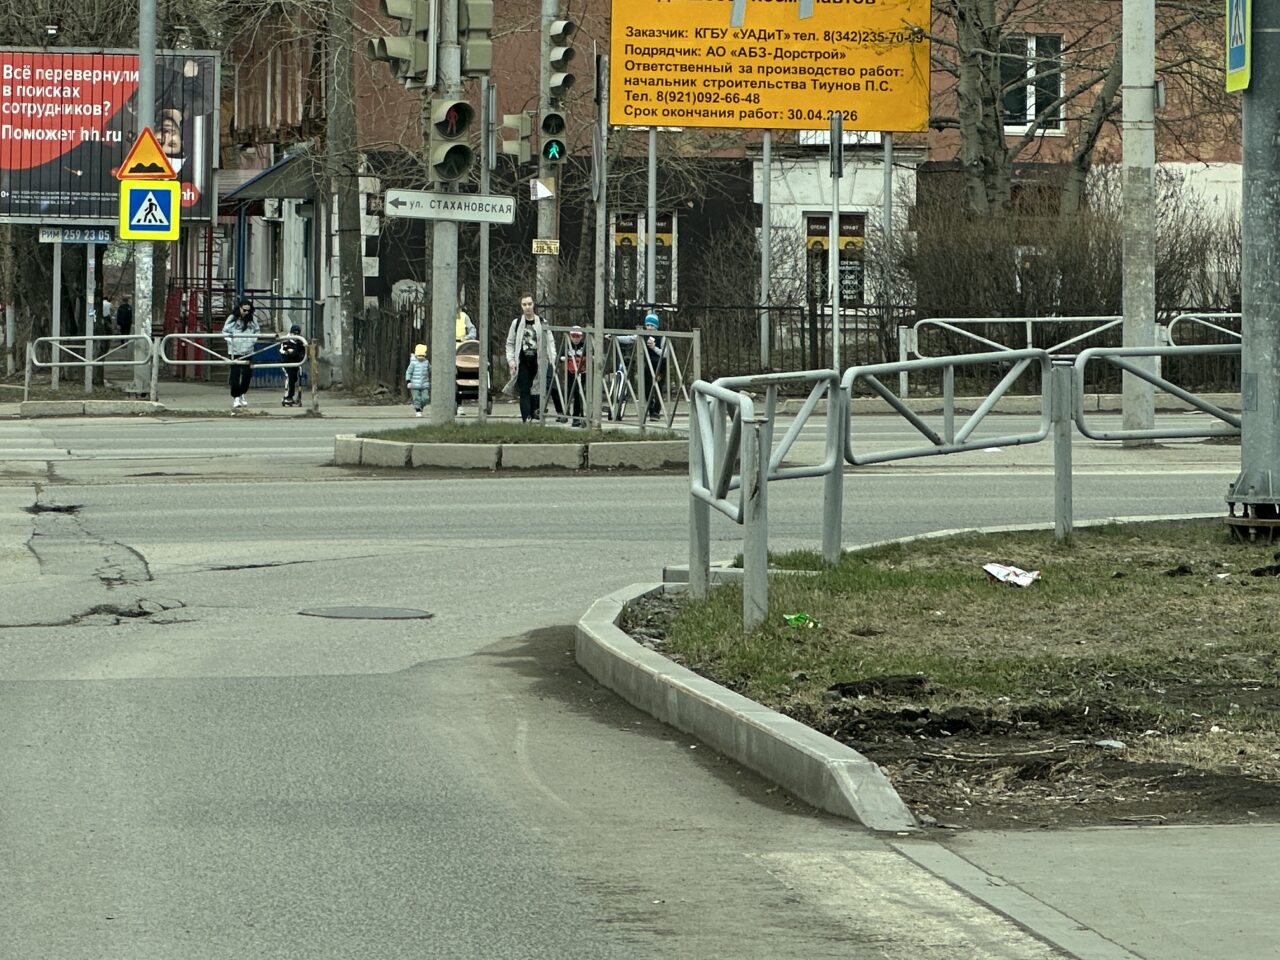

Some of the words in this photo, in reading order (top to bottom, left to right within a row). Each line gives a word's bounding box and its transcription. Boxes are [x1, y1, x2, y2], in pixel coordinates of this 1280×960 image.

[626, 26, 688, 38] Заказчик:
[695, 27, 728, 39] КГБУ
[733, 28, 791, 42] «УАДиТ»
[792, 32, 820, 42] тел.
[624, 44, 701, 58] Подрядчик:
[706, 46, 726, 57] АО
[730, 46, 846, 62] «АБЗ-Дорстрой»
[3, 64, 31, 80] Всё
[35, 68, 139, 86] перевернули
[624, 59, 733, 73] Ответственный
[738, 65, 753, 74] за
[757, 65, 856, 77] производство
[860, 65, 904, 79] работ:
[2, 85, 12, 97] в
[16, 85, 80, 98] поисках
[624, 77, 697, 87] начальник
[703, 79, 807, 90] строительства
[810, 78, 861, 92] Тиунов
[865, 80, 892, 92] П.С.
[624, 90, 652, 102] Тел.
[656, 90, 760, 105] 8(921)092-66-48
[1, 100, 111, 118] сотрудников?
[624, 105, 658, 119] Срок
[661, 108, 735, 118] окончания
[739, 108, 783, 121] работ:
[787, 109, 858, 122] 30.04.226
[1, 124, 76, 141] Поможет
[80, 126, 122, 143] hh.ru
[409, 200, 424, 210] ул.
[429, 199, 512, 214] СТАХАНОВСКАЯ
[64, 230, 81, 240] 259
[84, 230, 96, 240] 23
[98, 230, 110, 240] 05
